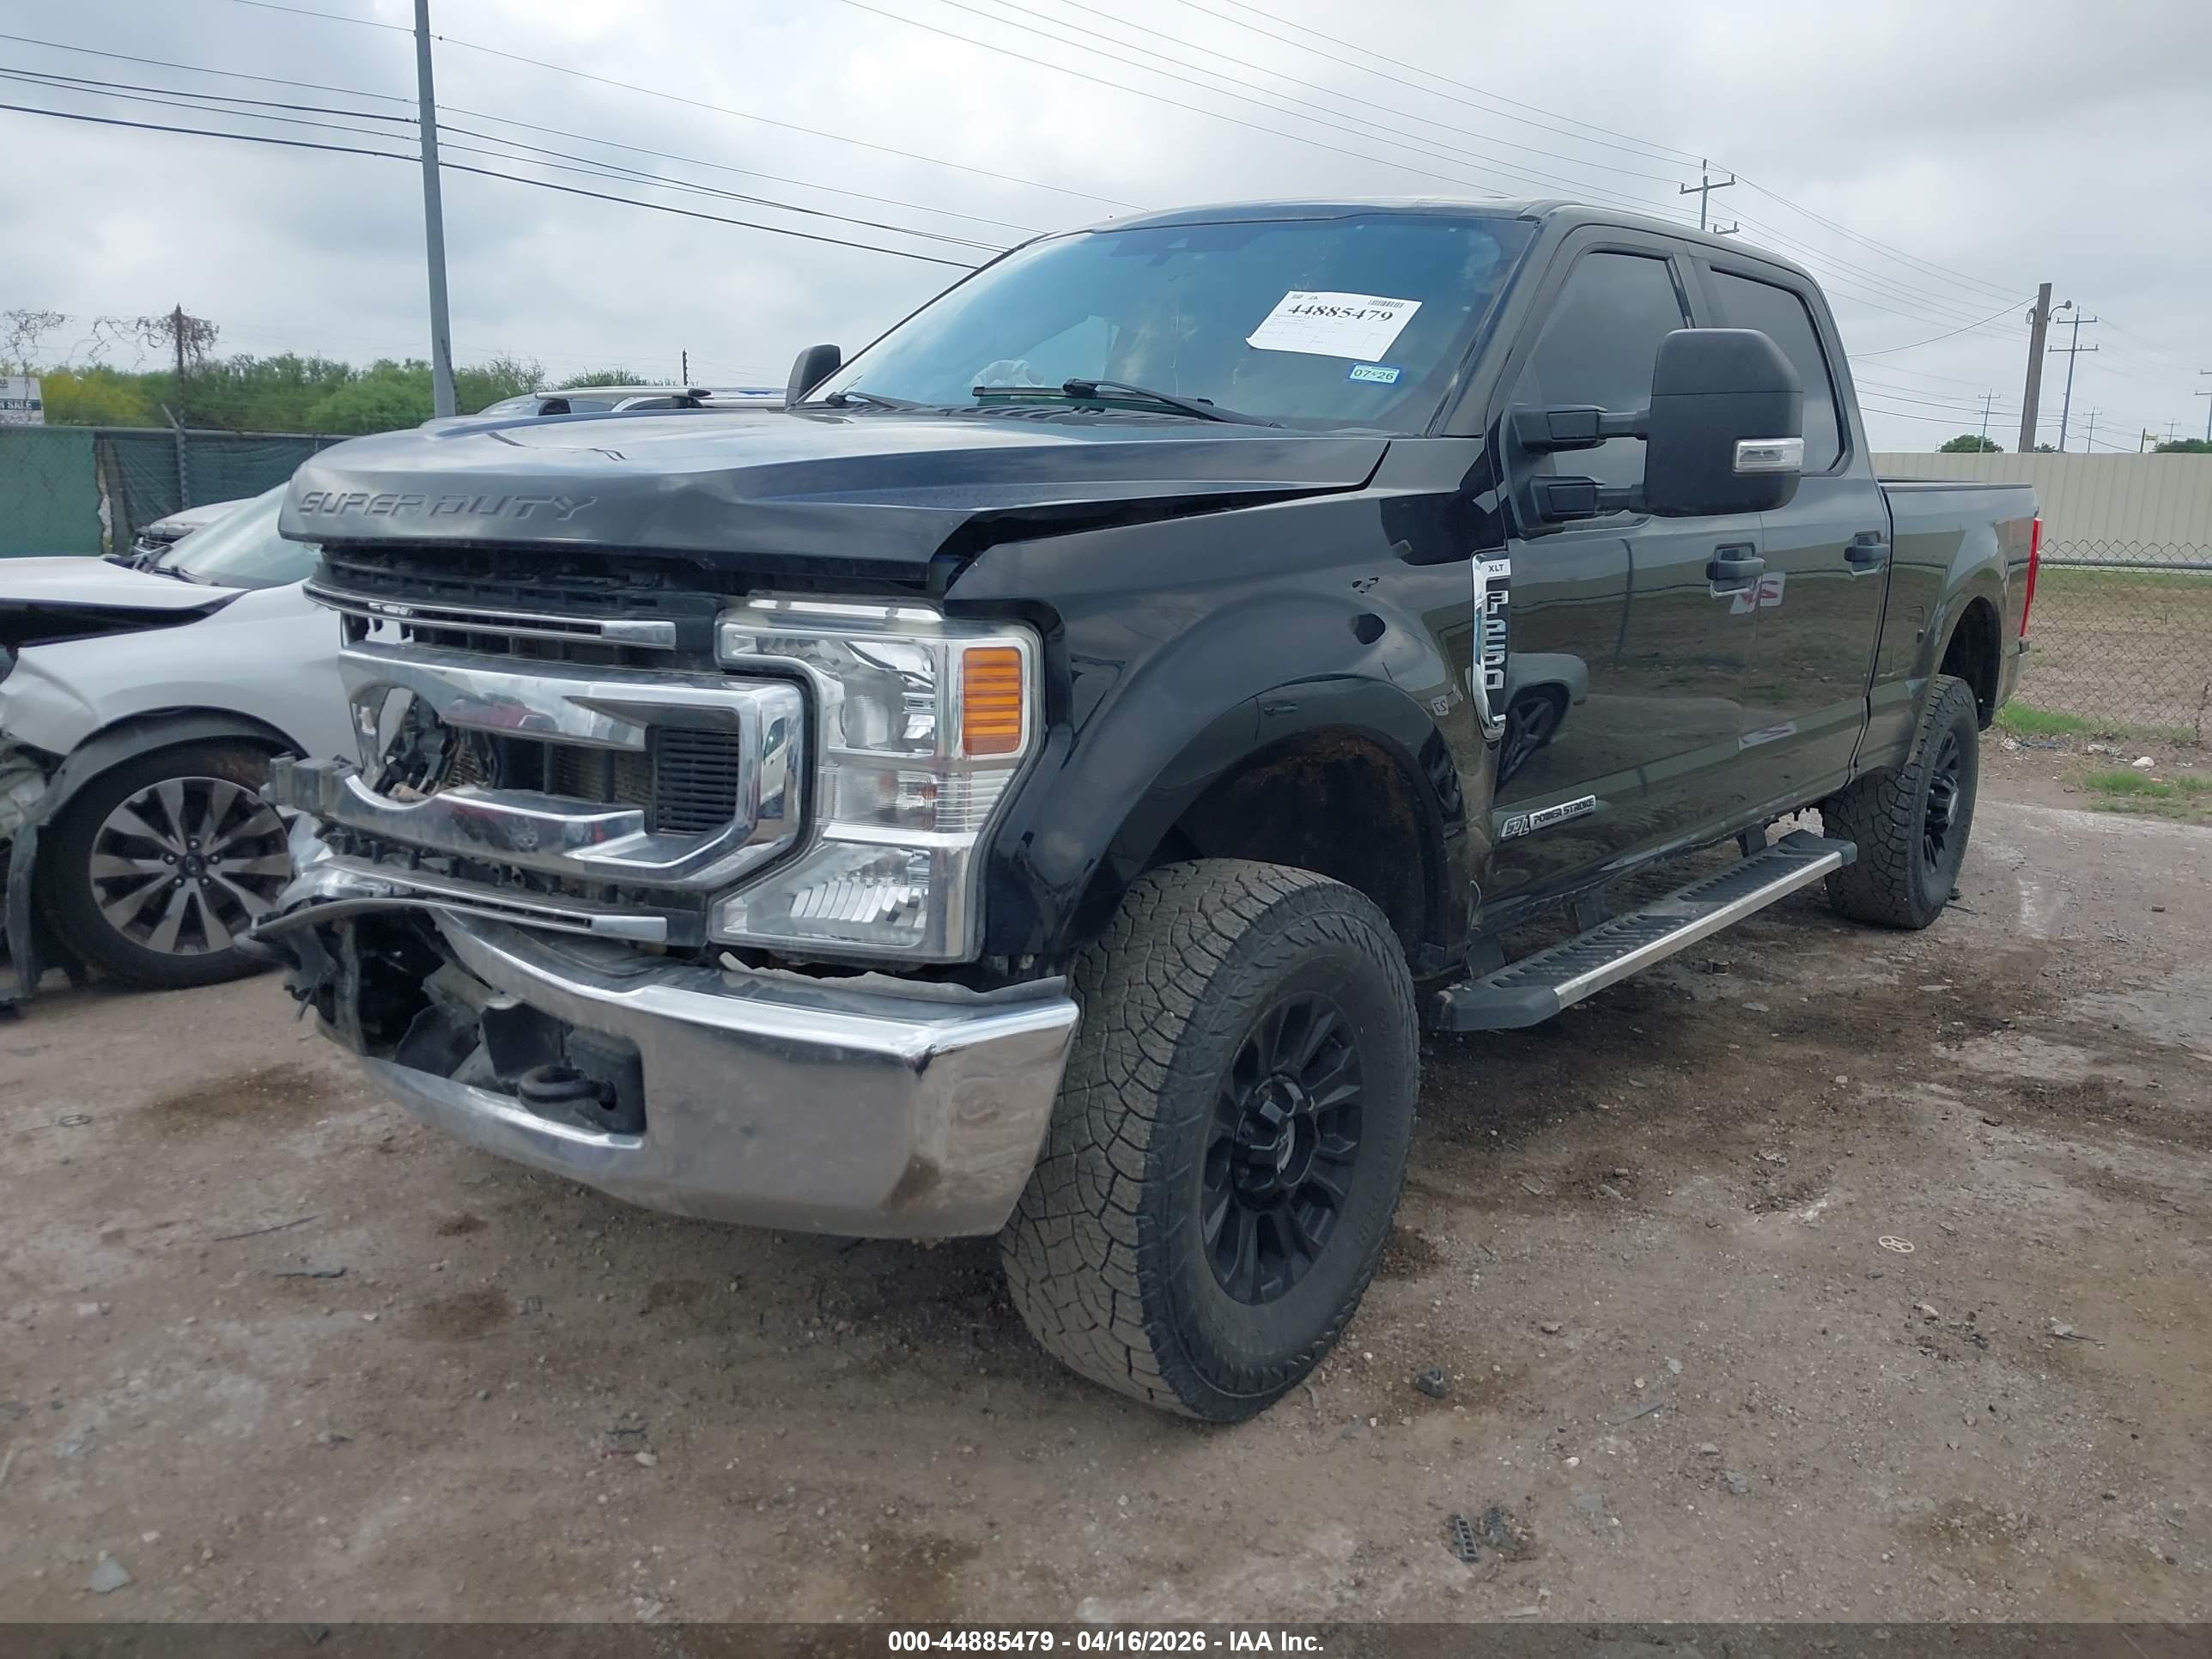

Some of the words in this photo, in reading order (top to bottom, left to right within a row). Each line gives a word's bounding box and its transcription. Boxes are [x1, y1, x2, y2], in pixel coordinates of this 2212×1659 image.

[1287, 303, 1394, 322] 44885479
[1354, 368, 1371, 378] 07
[1376, 371, 1395, 380] 26
[298, 491, 427, 516] SUPER
[429, 495, 599, 521] DUTY
[1488, 563, 1504, 573] XLT
[1533, 807, 1563, 824] POWER
[1563, 797, 1595, 816] STROKE
